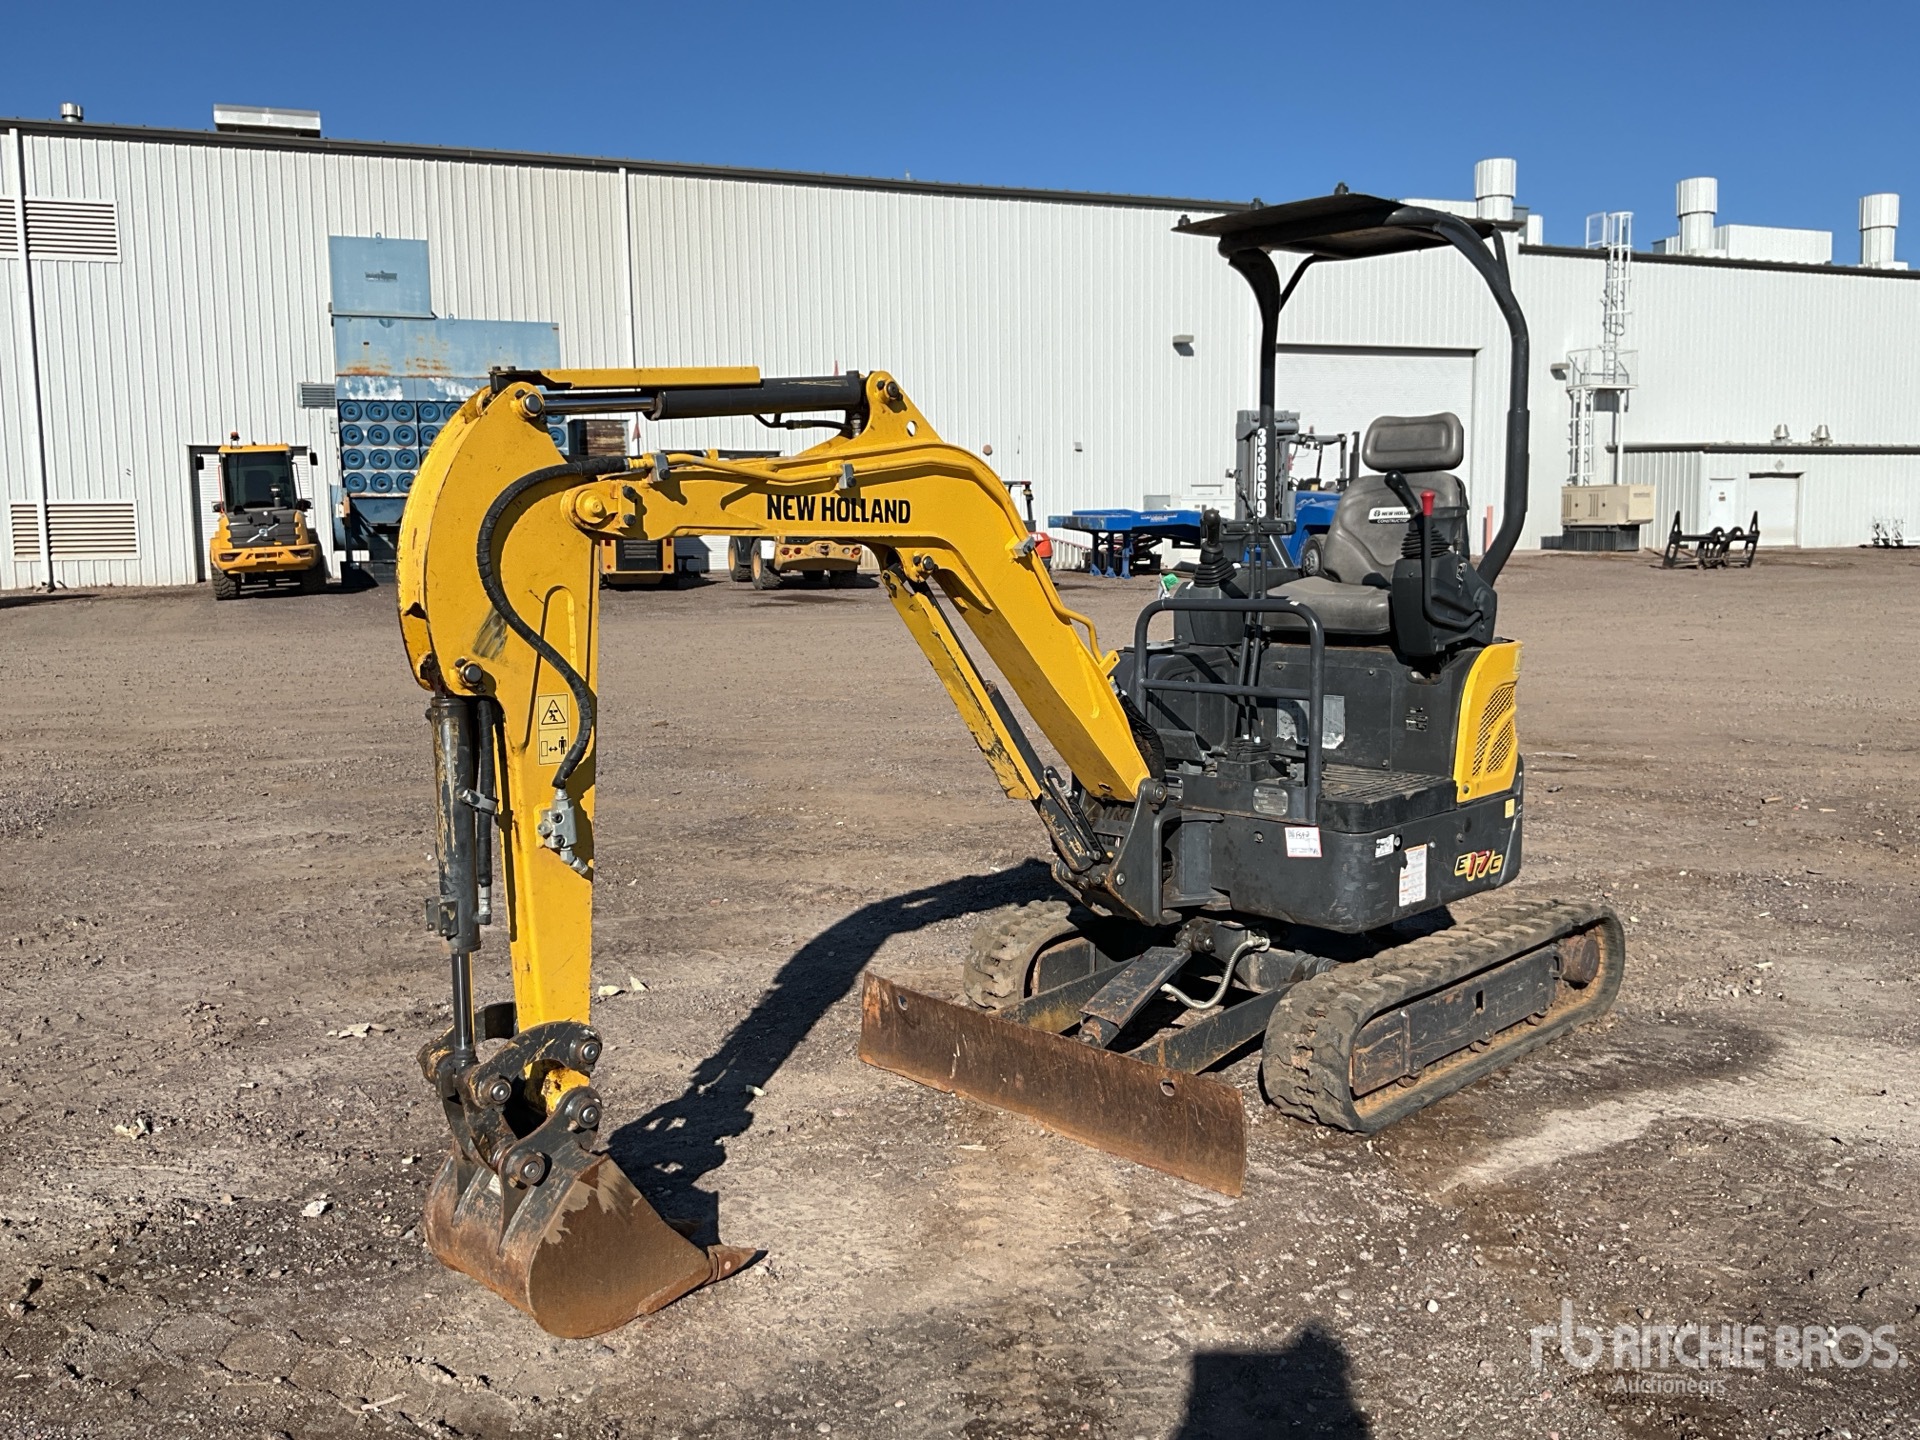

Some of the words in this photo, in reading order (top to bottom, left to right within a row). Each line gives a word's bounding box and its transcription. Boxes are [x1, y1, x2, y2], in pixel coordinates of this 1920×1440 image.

[1257, 427, 1267, 518] 33669
[767, 494, 816, 521] NEW
[821, 496, 911, 524] HOLLAND
